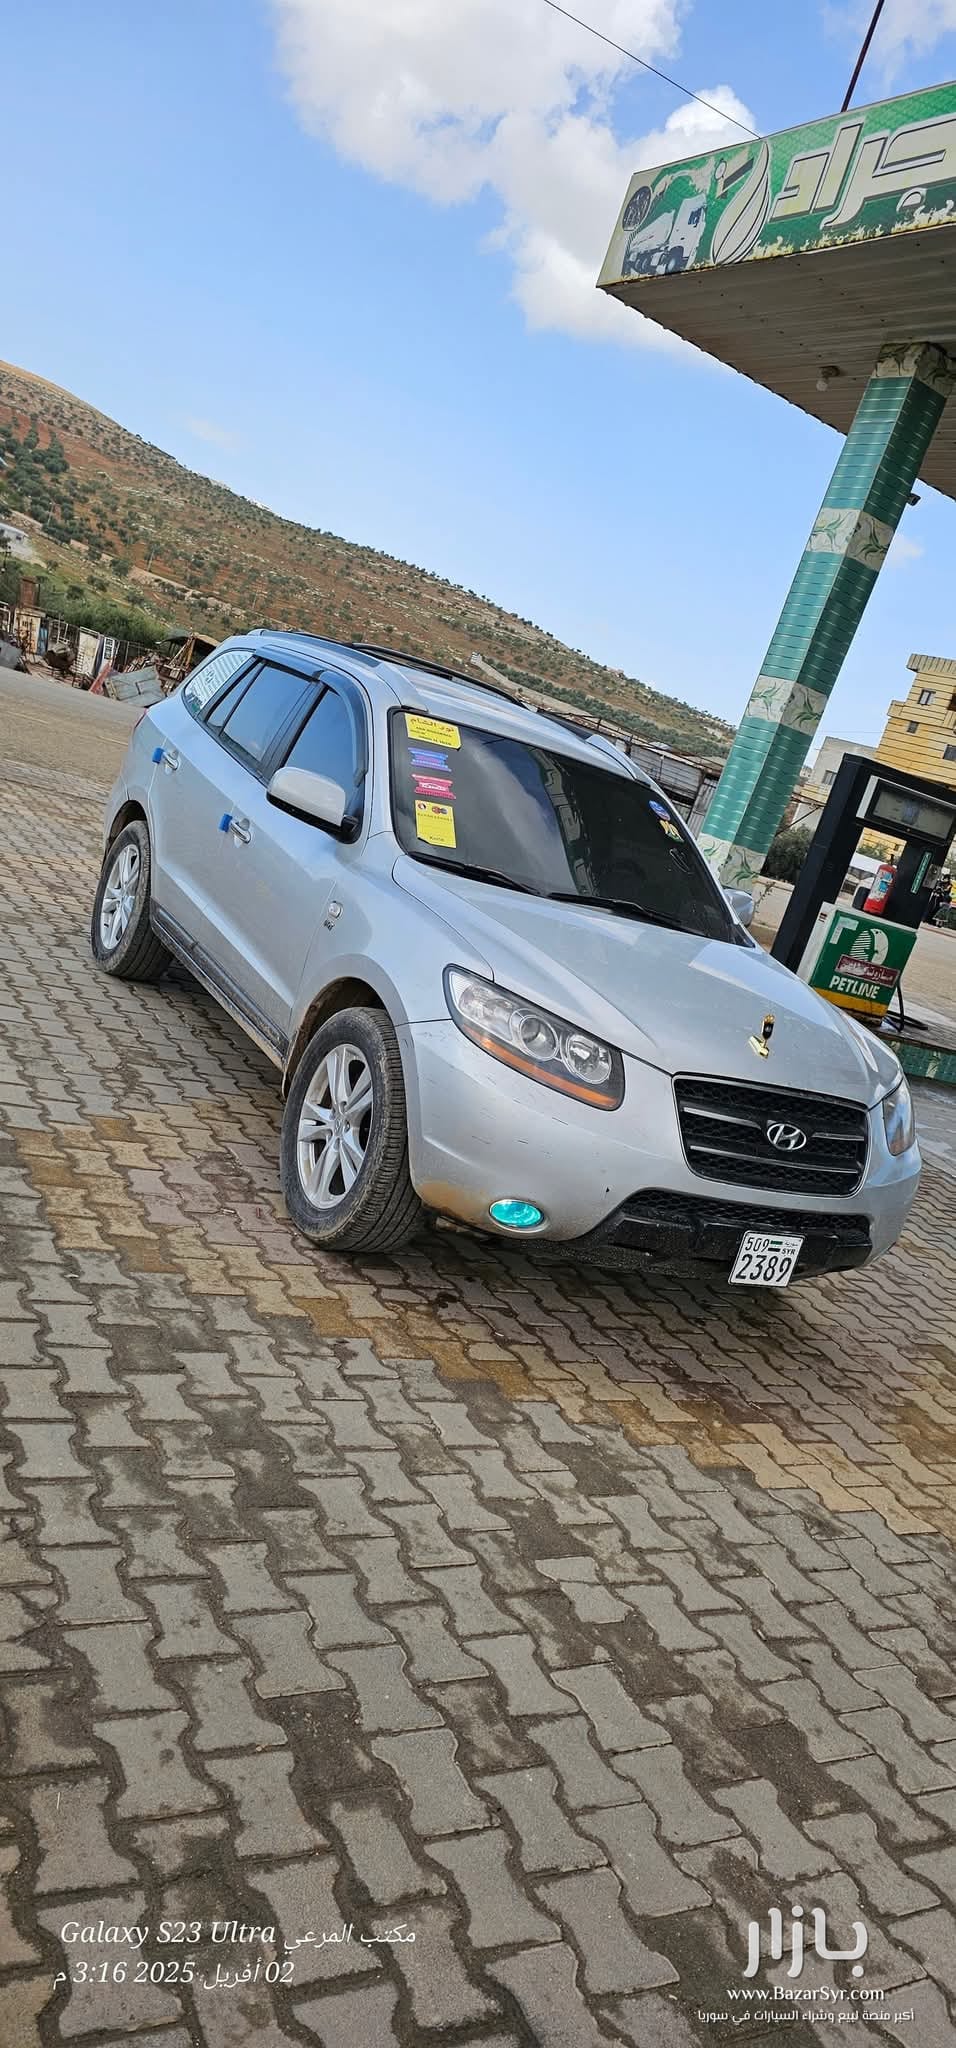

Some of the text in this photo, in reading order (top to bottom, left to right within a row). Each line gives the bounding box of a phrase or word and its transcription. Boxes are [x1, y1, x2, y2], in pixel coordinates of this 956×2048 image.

[828, 975, 881, 999] PETLINE
[745, 1237, 770, 1252] 509
[736, 1254, 791, 1282] 2389
